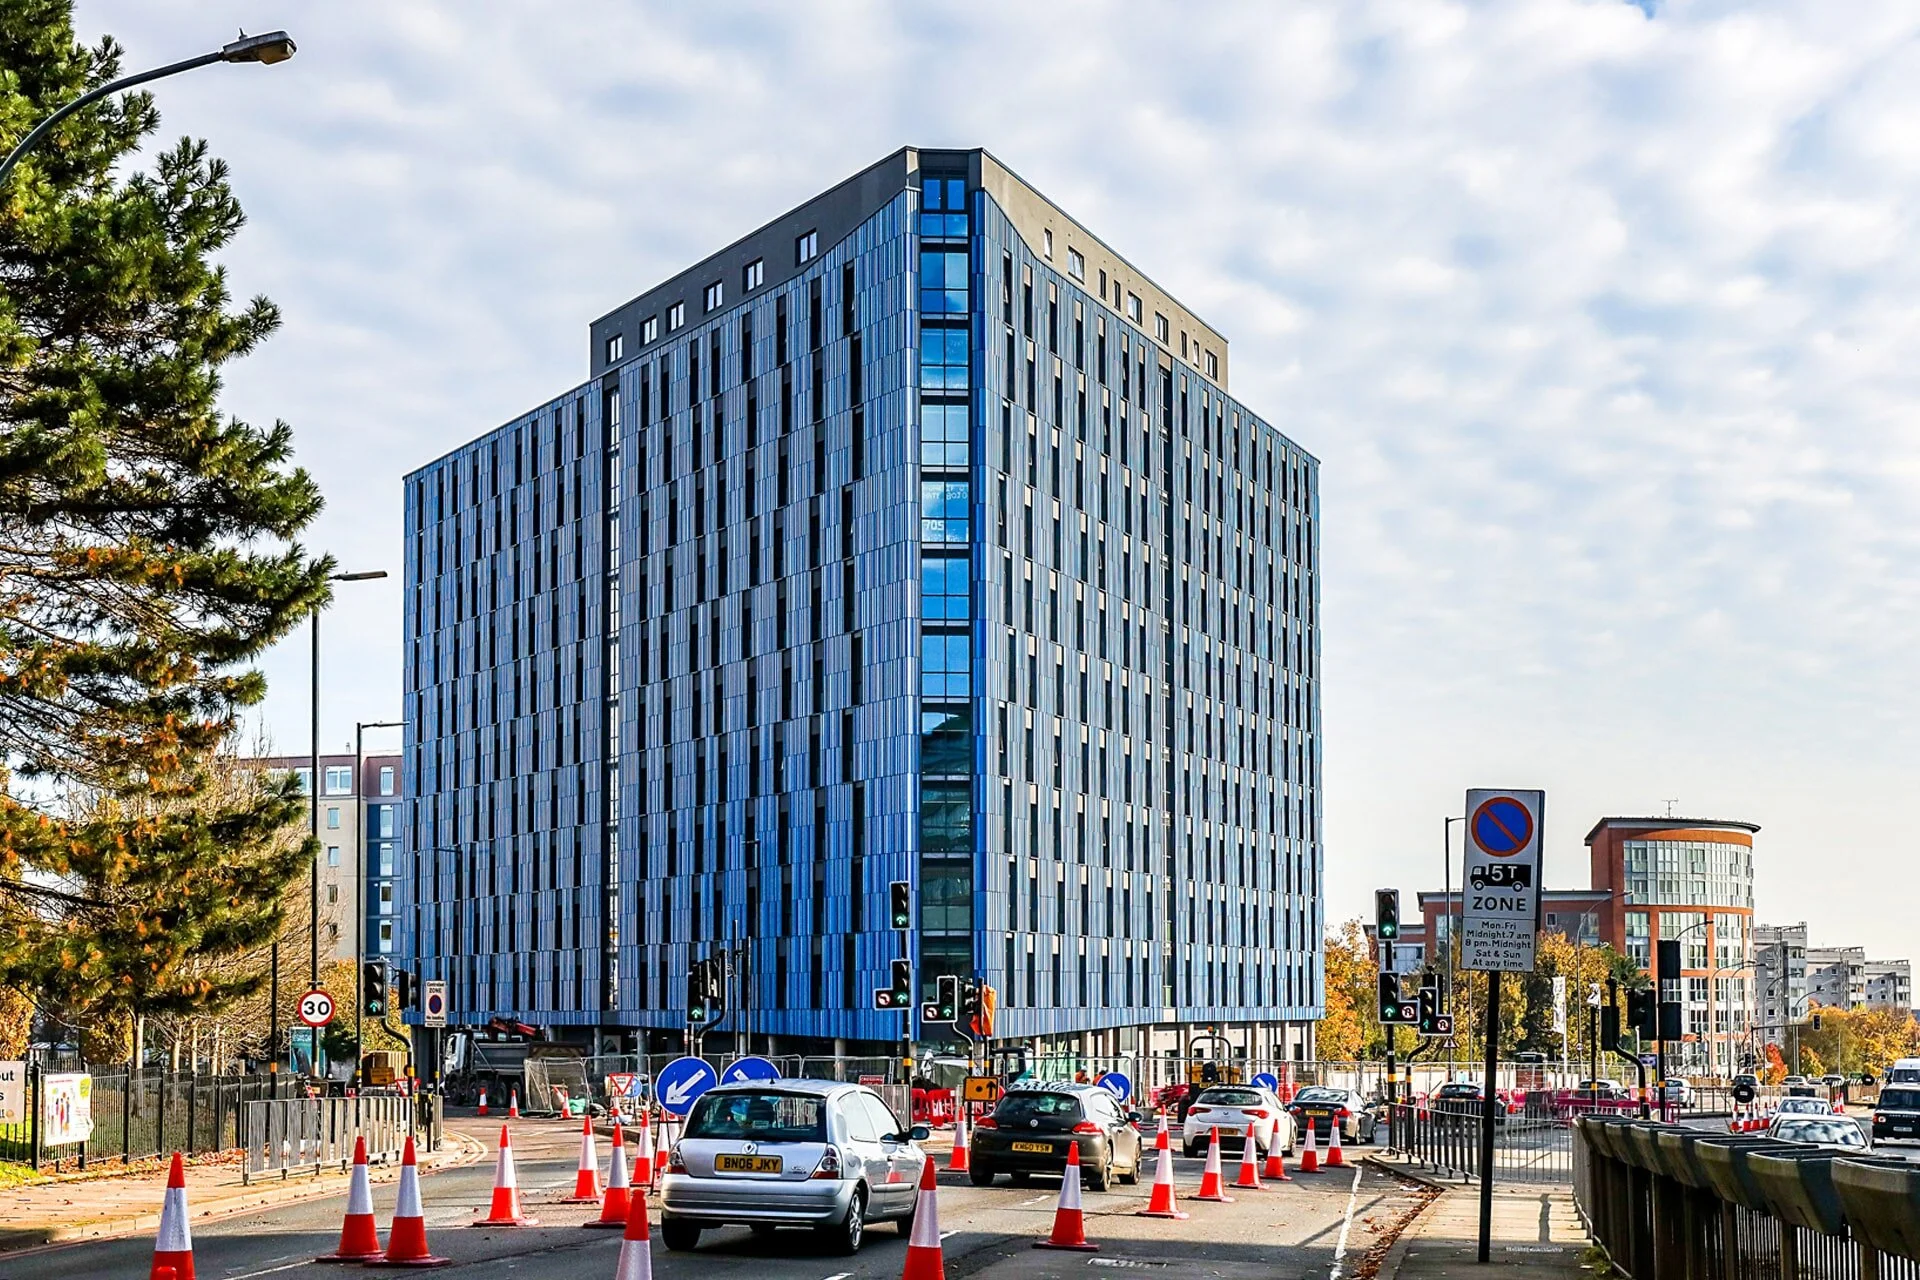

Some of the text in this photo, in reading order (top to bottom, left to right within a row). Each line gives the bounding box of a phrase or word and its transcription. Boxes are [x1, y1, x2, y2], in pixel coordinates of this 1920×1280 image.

[1472, 896, 1527, 911] ZONE
[1465, 938, 1471, 946] 8
[1475, 949, 1491, 957] Sat
[1472, 958, 1524, 968] At any time
[303, 1000, 330, 1016] 30
[0, 1070, 15, 1082] ut
[723, 1156, 753, 1169] BN06
[756, 1158, 779, 1171] JKY
